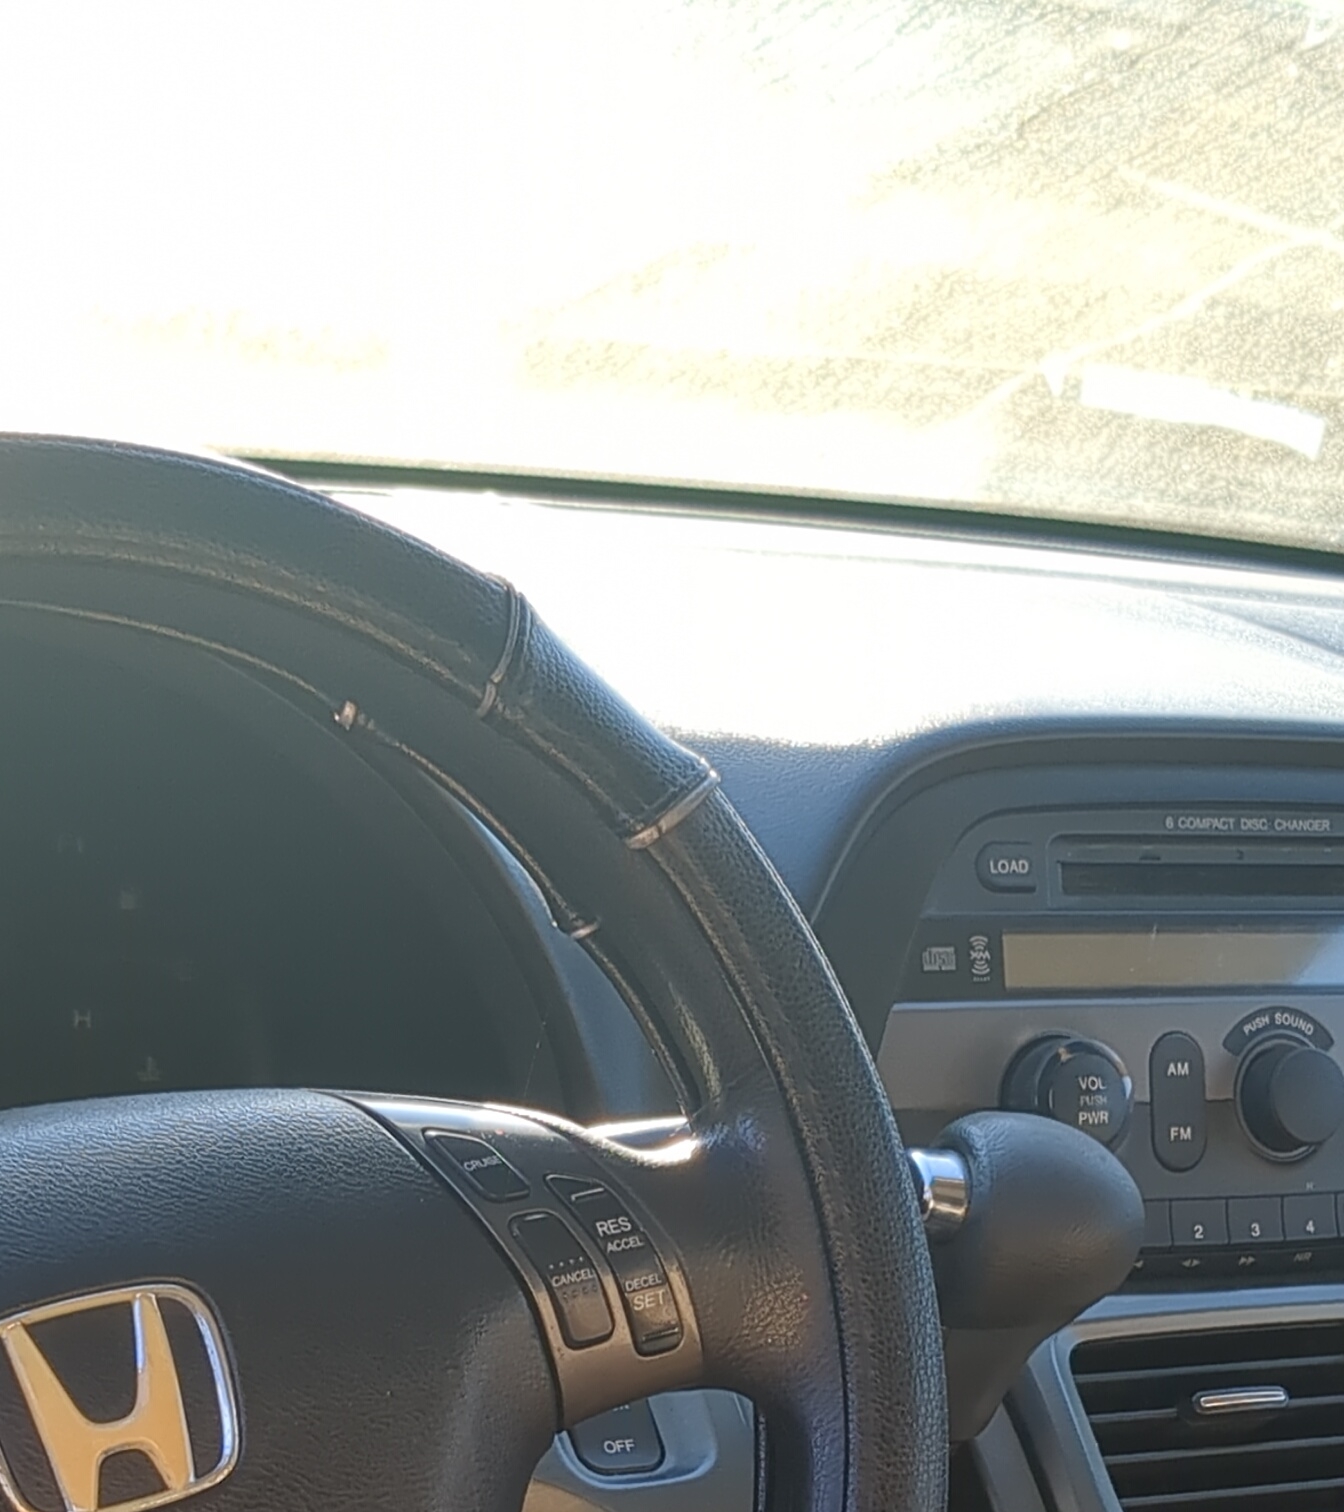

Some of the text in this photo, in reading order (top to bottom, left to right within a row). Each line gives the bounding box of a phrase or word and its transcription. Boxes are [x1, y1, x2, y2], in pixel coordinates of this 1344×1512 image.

[1165, 816, 1331, 832] 6 COMPACT DISC CHANGER
[989, 859, 1029, 874] LOAD
[1243, 1012, 1315, 1036] PUSH SOUND
[1167, 1062, 1189, 1076] AM
[1078, 1076, 1106, 1090] VOL
[1078, 1111, 1108, 1125] PWR
[1170, 1127, 1192, 1141] FM
[463, 1155, 502, 1171] CRUISE
[595, 1216, 632, 1238] RES
[1193, 1225, 1204, 1239] 2
[1251, 1222, 1261, 1237] 3
[1306, 1220, 1315, 1234] 4
[606, 1236, 645, 1254] ACCEL
[551, 1267, 594, 1287] CANCEL
[624, 1273, 662, 1293] DECEL
[632, 1288, 666, 1311] SET
[603, 1439, 635, 1454] OFF
